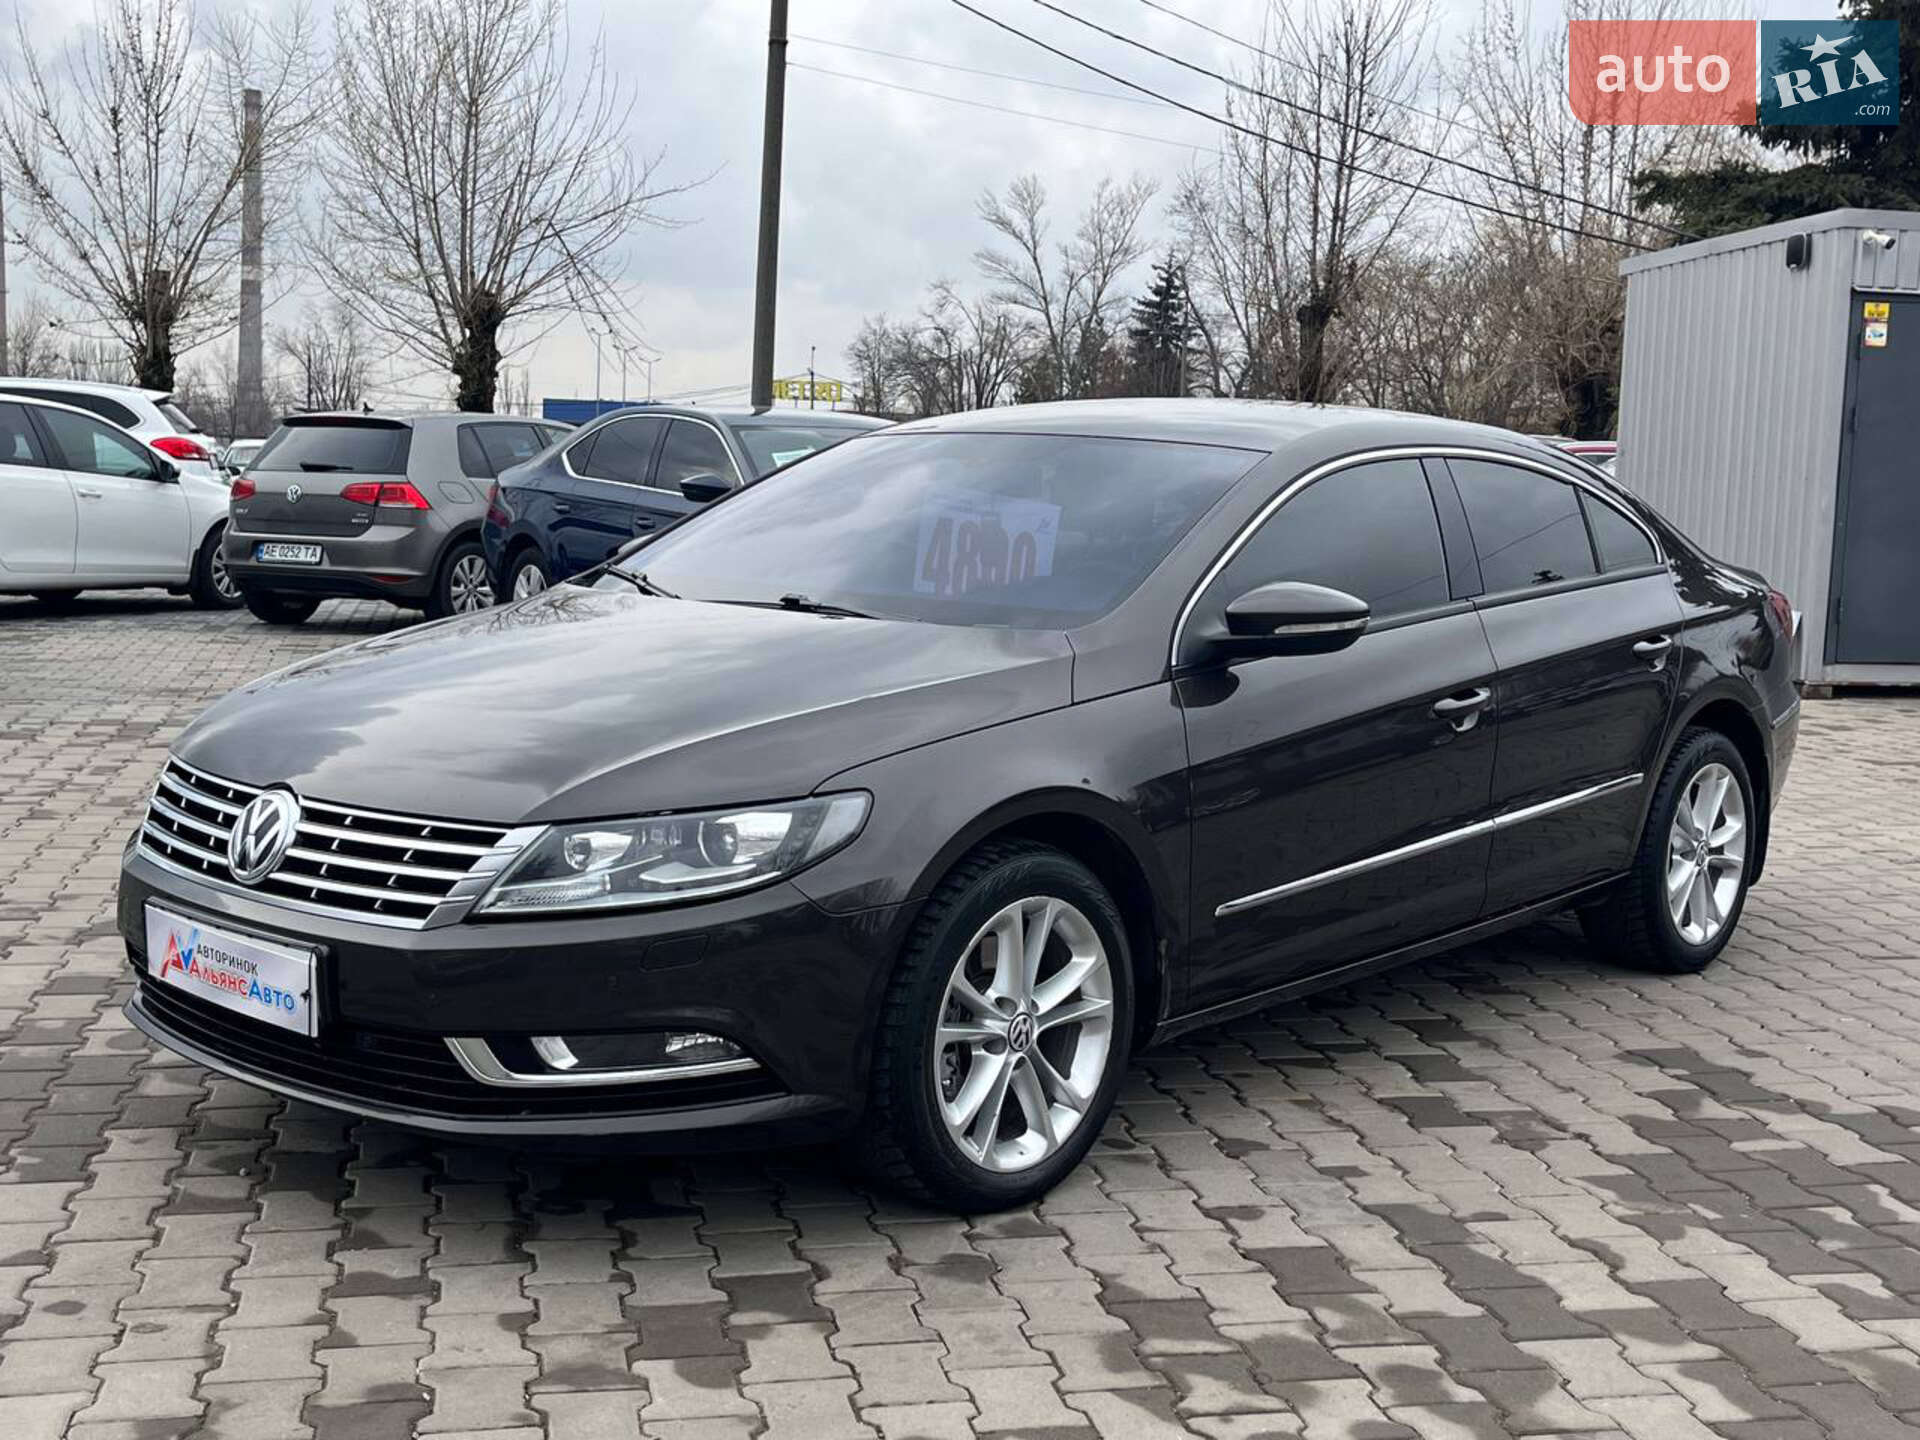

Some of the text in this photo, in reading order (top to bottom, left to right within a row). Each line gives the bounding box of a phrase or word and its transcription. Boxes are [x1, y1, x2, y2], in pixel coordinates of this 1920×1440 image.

[264, 544, 318, 560] AE 0252 TA
